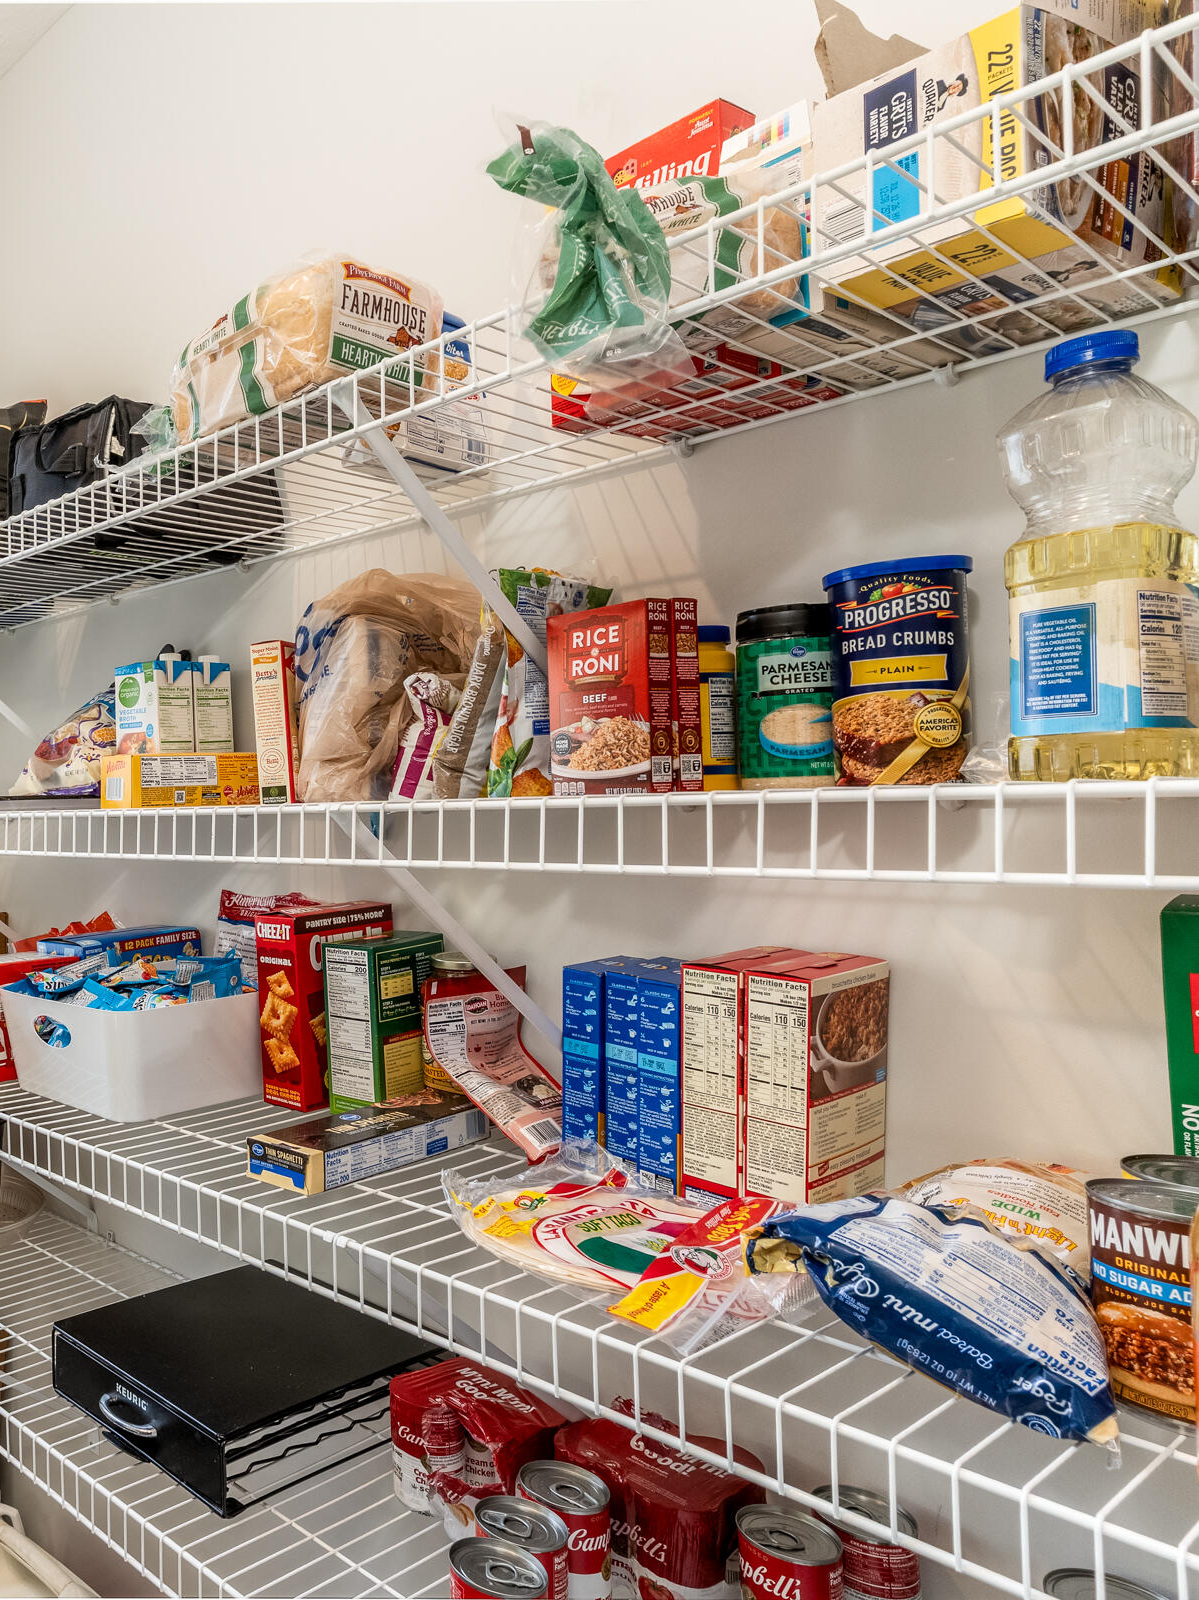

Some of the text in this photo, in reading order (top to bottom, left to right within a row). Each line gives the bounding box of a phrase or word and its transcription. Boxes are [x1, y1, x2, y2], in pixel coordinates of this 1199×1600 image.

[988, 43, 1013, 73] 22
[988, 65, 1013, 81] PACKETS
[921, 78, 935, 123] QUAKER
[695, 117, 710, 128] Aunt
[879, 105, 889, 140] FLAVOR
[891, 91, 908, 140] GRITS
[688, 121, 713, 139] Jemima
[868, 107, 879, 145] VARIETY
[668, 213, 702, 229] WHITE
[951, 244, 997, 264] 22
[389, 279, 407, 296] FARM
[341, 283, 427, 334] FARMHOUSE
[339, 321, 384, 341] CRAFTED BAKED GOODS
[342, 342, 382, 369] HEARTY
[859, 575, 898, 593] Quality
[1139, 593, 1165, 601] Nutrition
[648, 602, 667, 611] RICE
[675, 602, 694, 611] RICE
[844, 590, 951, 629] PROGRESSO
[648, 612, 668, 621] RONI
[675, 612, 695, 621] RONI
[572, 625, 620, 649] RICE
[1141, 624, 1182, 634] Calories 120
[841, 631, 955, 655] BREAD CRUMBS
[1049, 638, 1081, 646] CHOLESTEROL
[255, 669, 278, 678] Betty's
[571, 653, 619, 677] RONI
[880, 665, 915, 675] PLAIN
[467, 662, 487, 689] DARK
[770, 670, 827, 685] CHEESE
[458, 686, 479, 727] BROWN
[582, 694, 607, 704] BEEF
[119, 707, 147, 716] VEGETABLE
[119, 715, 137, 723] BROTH
[927, 707, 952, 715] PROGRESSO
[919, 718, 959, 727] AMERICA'S
[447, 721, 466, 754] SUGAR
[770, 745, 826, 757] PARMESAN
[306, 914, 364, 929] PANTRY SIZE 75%
[124, 931, 197, 950] 12 PACK FAMILY SIZE
[260, 955, 292, 967] ORIGINAL
[327, 948, 366, 958] Nutrition Facts
[355, 966, 367, 974] 200
[685, 970, 736, 983] Nutrition Facts
[750, 977, 807, 991] Nutrition Facts
[466, 1000, 487, 1011] IDAHOAN
[685, 1003, 736, 1017] Calories 110 150
[750, 1012, 806, 1027] Calories 110 150
[265, 1146, 303, 1165] THIN SPAGHETTI
[326, 1149, 349, 1160] Nutrition
[326, 1158, 342, 1167] Facts
[829, 1158, 854, 1171] easy pleasing
[327, 1174, 350, 1185] Calories 200
[965, 1171, 1013, 1182] Simply Delicious
[986, 1189, 1061, 1217] Egg Noodles
[990, 1199, 1041, 1221] WIDE
[575, 1213, 642, 1233] SOFT TACO
[1025, 1223, 1078, 1253] Light
[868, 1242, 923, 1276] Total Carbohydrate
[1115, 1256, 1191, 1285] ORIGINAL
[660, 1281, 671, 1291] A
[1093, 1263, 1107, 1278] NO
[1109, 1272, 1163, 1297] SUGAR
[651, 1288, 668, 1304] Taste
[1105, 1286, 1165, 1311] SLOPPY JOE
[845, 1299, 870, 1315] ENLARGED
[1000, 1295, 1042, 1321] Cholesterol
[1019, 1298, 1044, 1316] Sodium
[1056, 1308, 1075, 1325] 70
[882, 1294, 994, 1370] Baked mini
[997, 1320, 1027, 1339] Total Fat
[1027, 1344, 1098, 1393] Nutrition
[1059, 1350, 1106, 1386] Facts
[456, 1367, 498, 1390] M'm!
[931, 1360, 997, 1407] NET WT 10 OZ
[116, 1382, 147, 1412] KEURIG
[1013, 1376, 1072, 1416] Kroger
